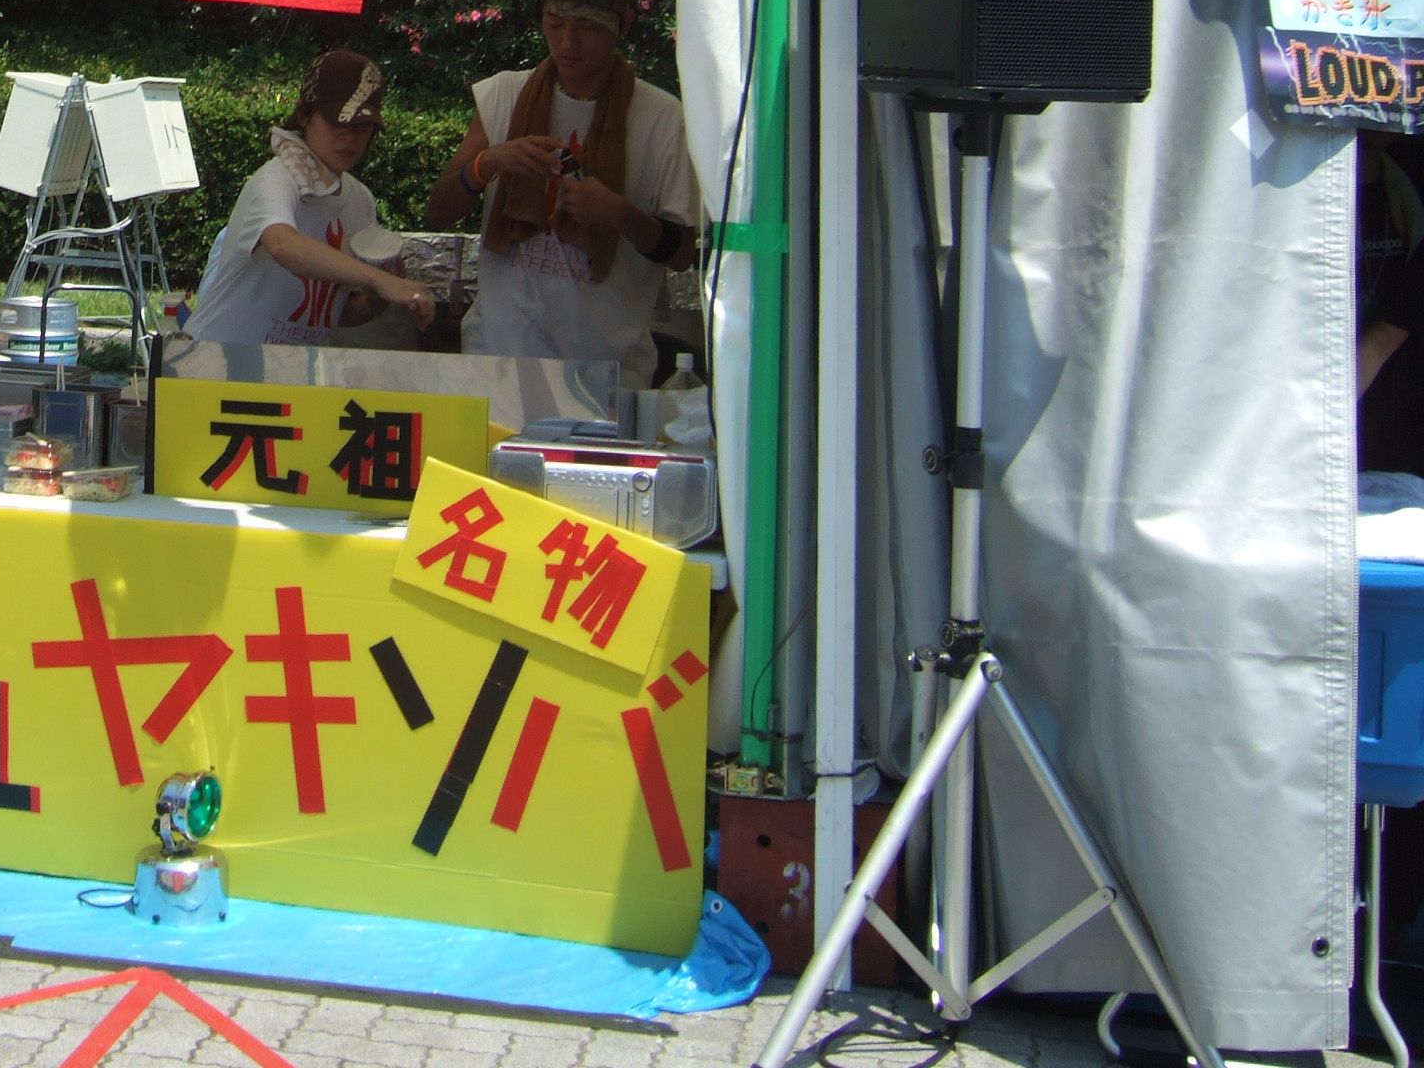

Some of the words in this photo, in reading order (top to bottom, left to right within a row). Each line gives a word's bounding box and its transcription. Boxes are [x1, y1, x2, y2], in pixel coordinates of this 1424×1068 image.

[1290, 38, 1405, 107] LOUD
[199, 398, 424, 501] 元祖
[416, 486, 648, 651] 名物
